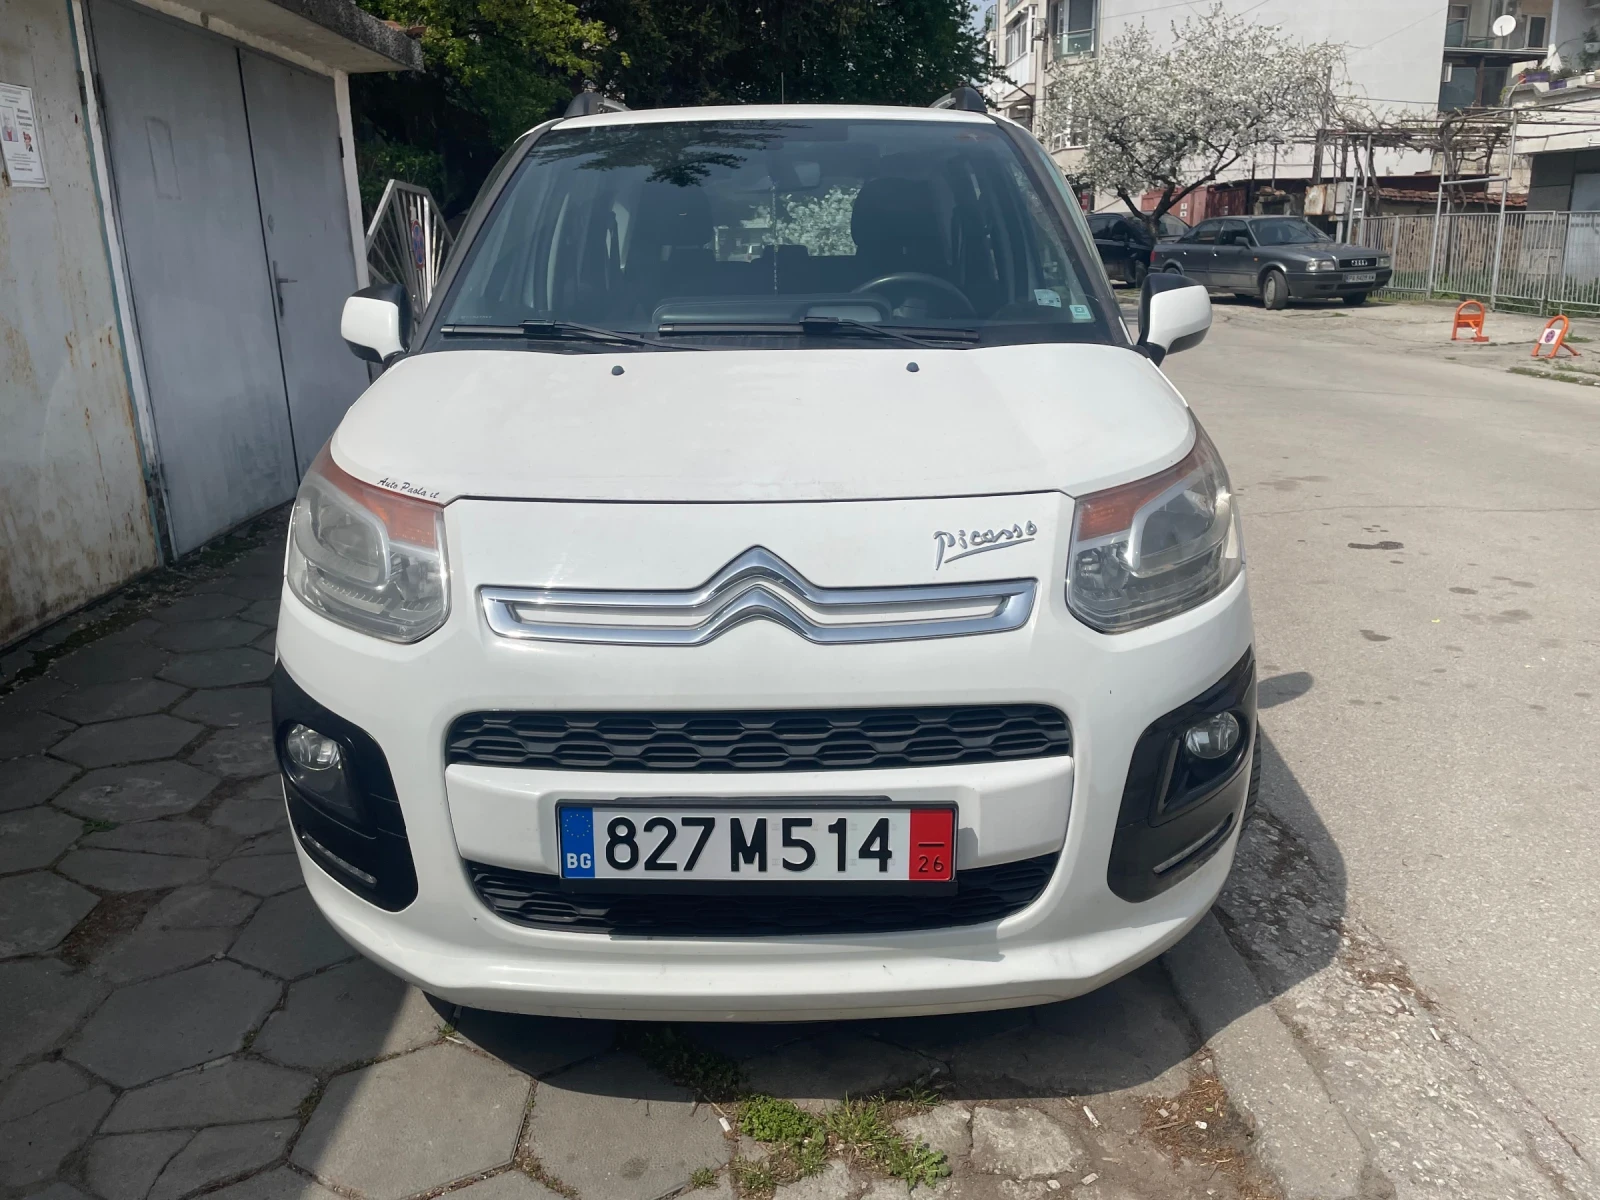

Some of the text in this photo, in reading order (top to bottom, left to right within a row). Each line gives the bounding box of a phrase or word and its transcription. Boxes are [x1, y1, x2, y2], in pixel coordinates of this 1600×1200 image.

[377, 478, 397, 488] Auto
[401, 482, 426, 496] Paola
[605, 816, 716, 872] 827
[566, 853, 592, 869] BG
[917, 854, 945, 873] 26
